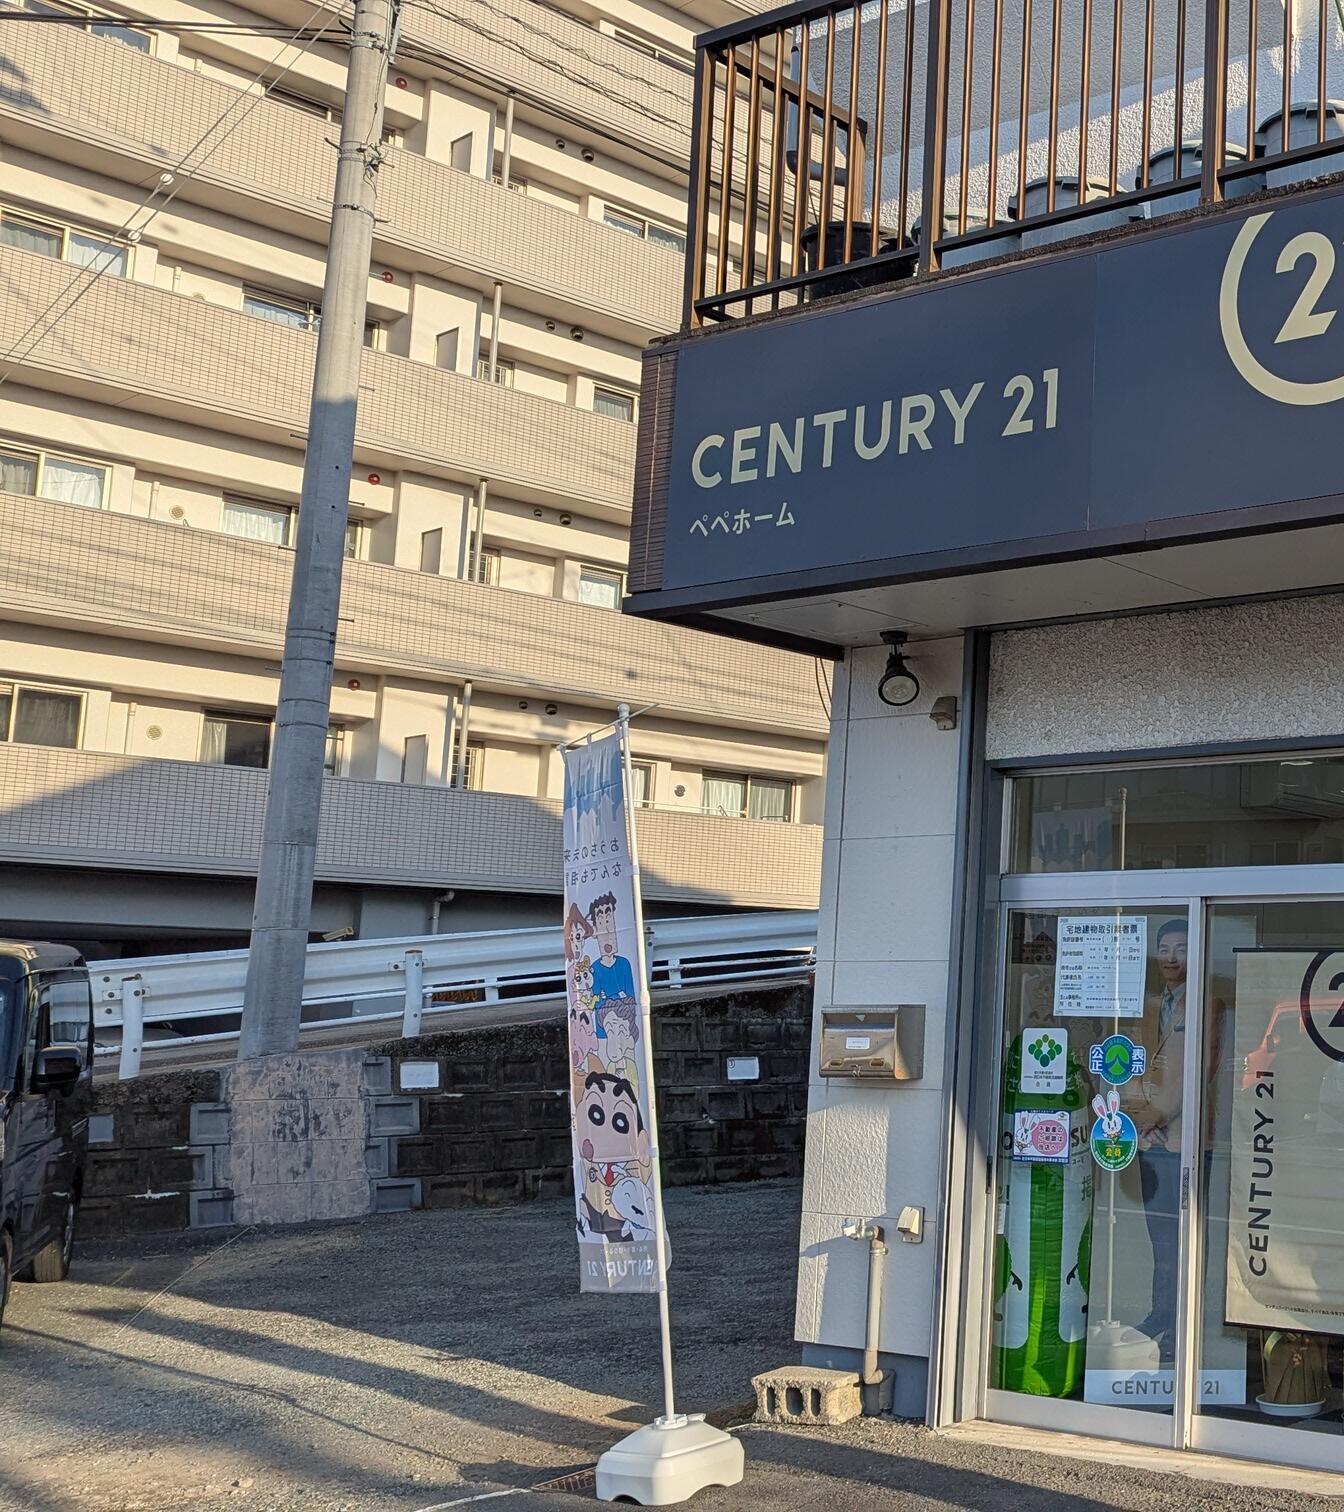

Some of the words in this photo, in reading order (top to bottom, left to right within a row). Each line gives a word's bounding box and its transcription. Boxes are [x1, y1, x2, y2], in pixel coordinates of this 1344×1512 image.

[691, 382, 985, 488] CENTURY
[1001, 368, 1059, 437] 21
[689, 502, 795, 536] ペペホーム
[1091, 1046, 1104, 1072] 公正
[1255, 1071, 1275, 1100] 21
[1248, 1109, 1275, 1277] CENTURY
[1111, 1380, 1174, 1395] CENTU
[1204, 1380, 1220, 1395] 21
